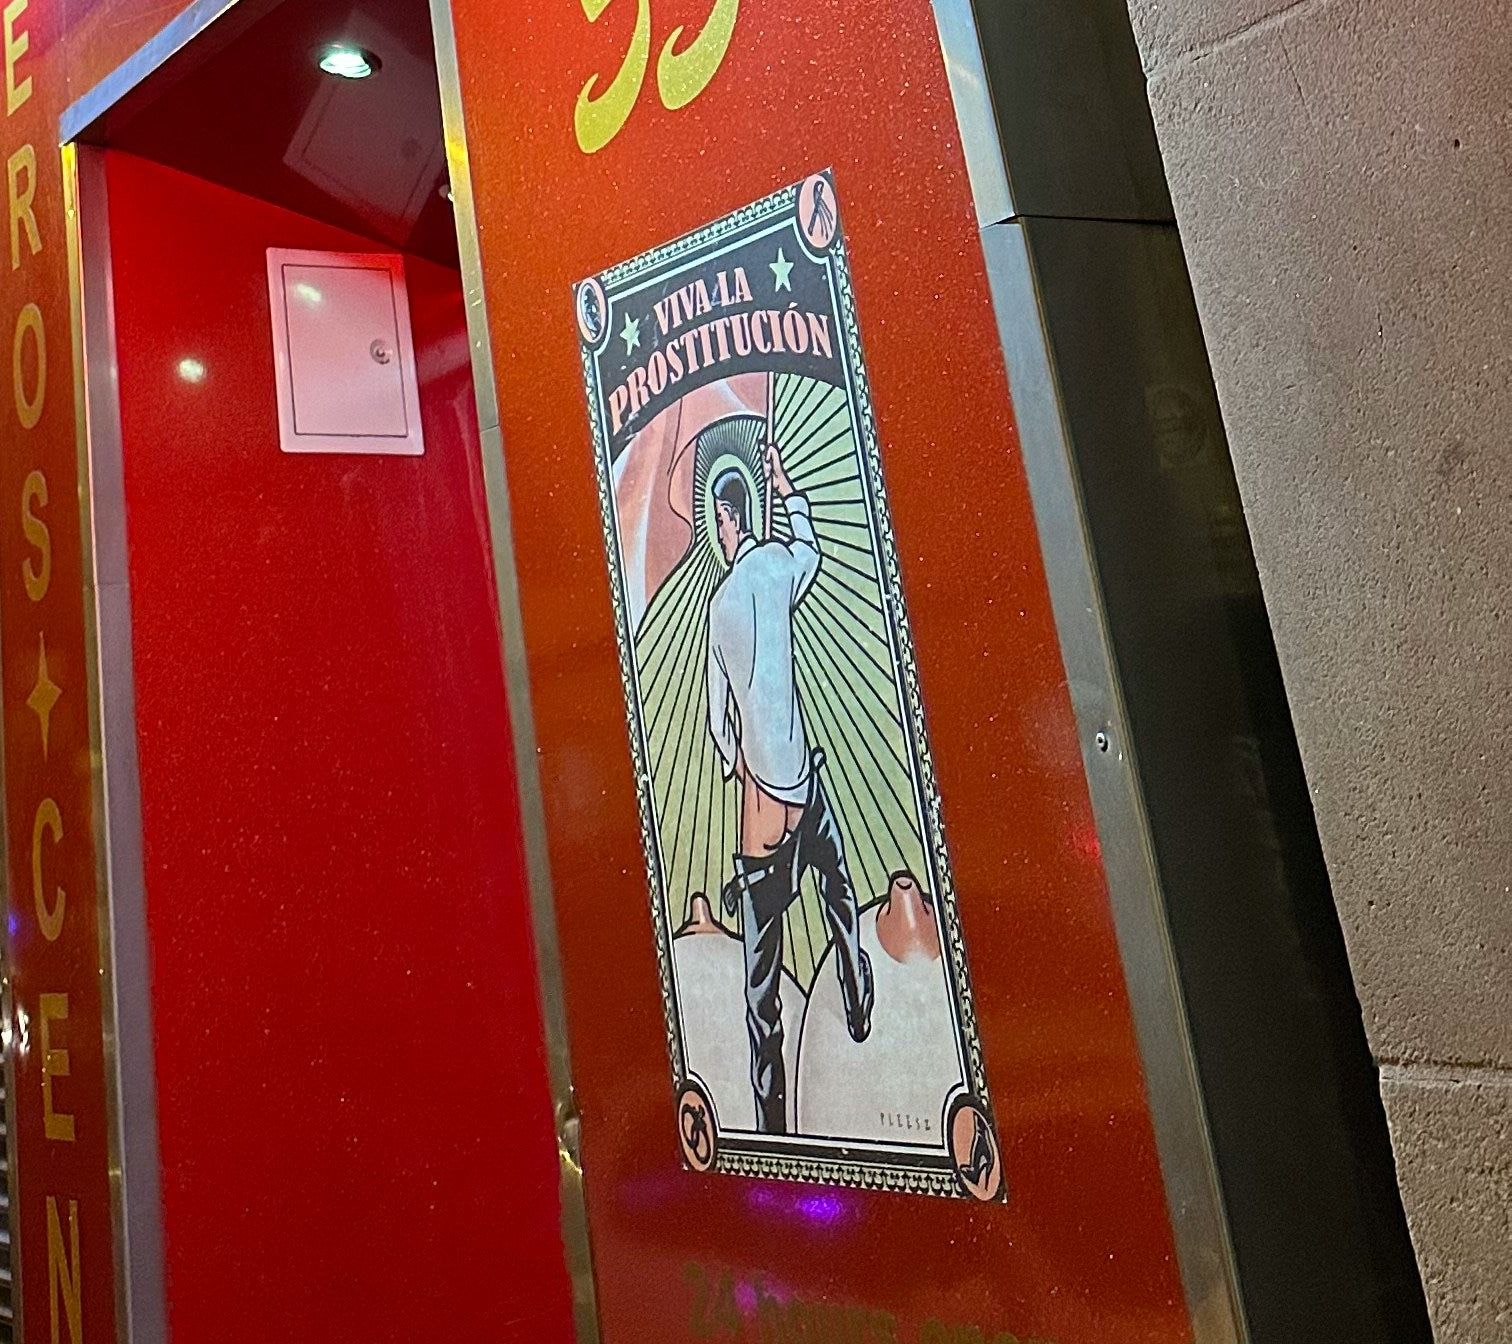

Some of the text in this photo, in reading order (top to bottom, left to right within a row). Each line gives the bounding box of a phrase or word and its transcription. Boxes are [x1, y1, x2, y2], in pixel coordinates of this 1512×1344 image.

[653, 266, 754, 336] VIVA LA
[607, 302, 834, 437] PROSTITUCIÓN
